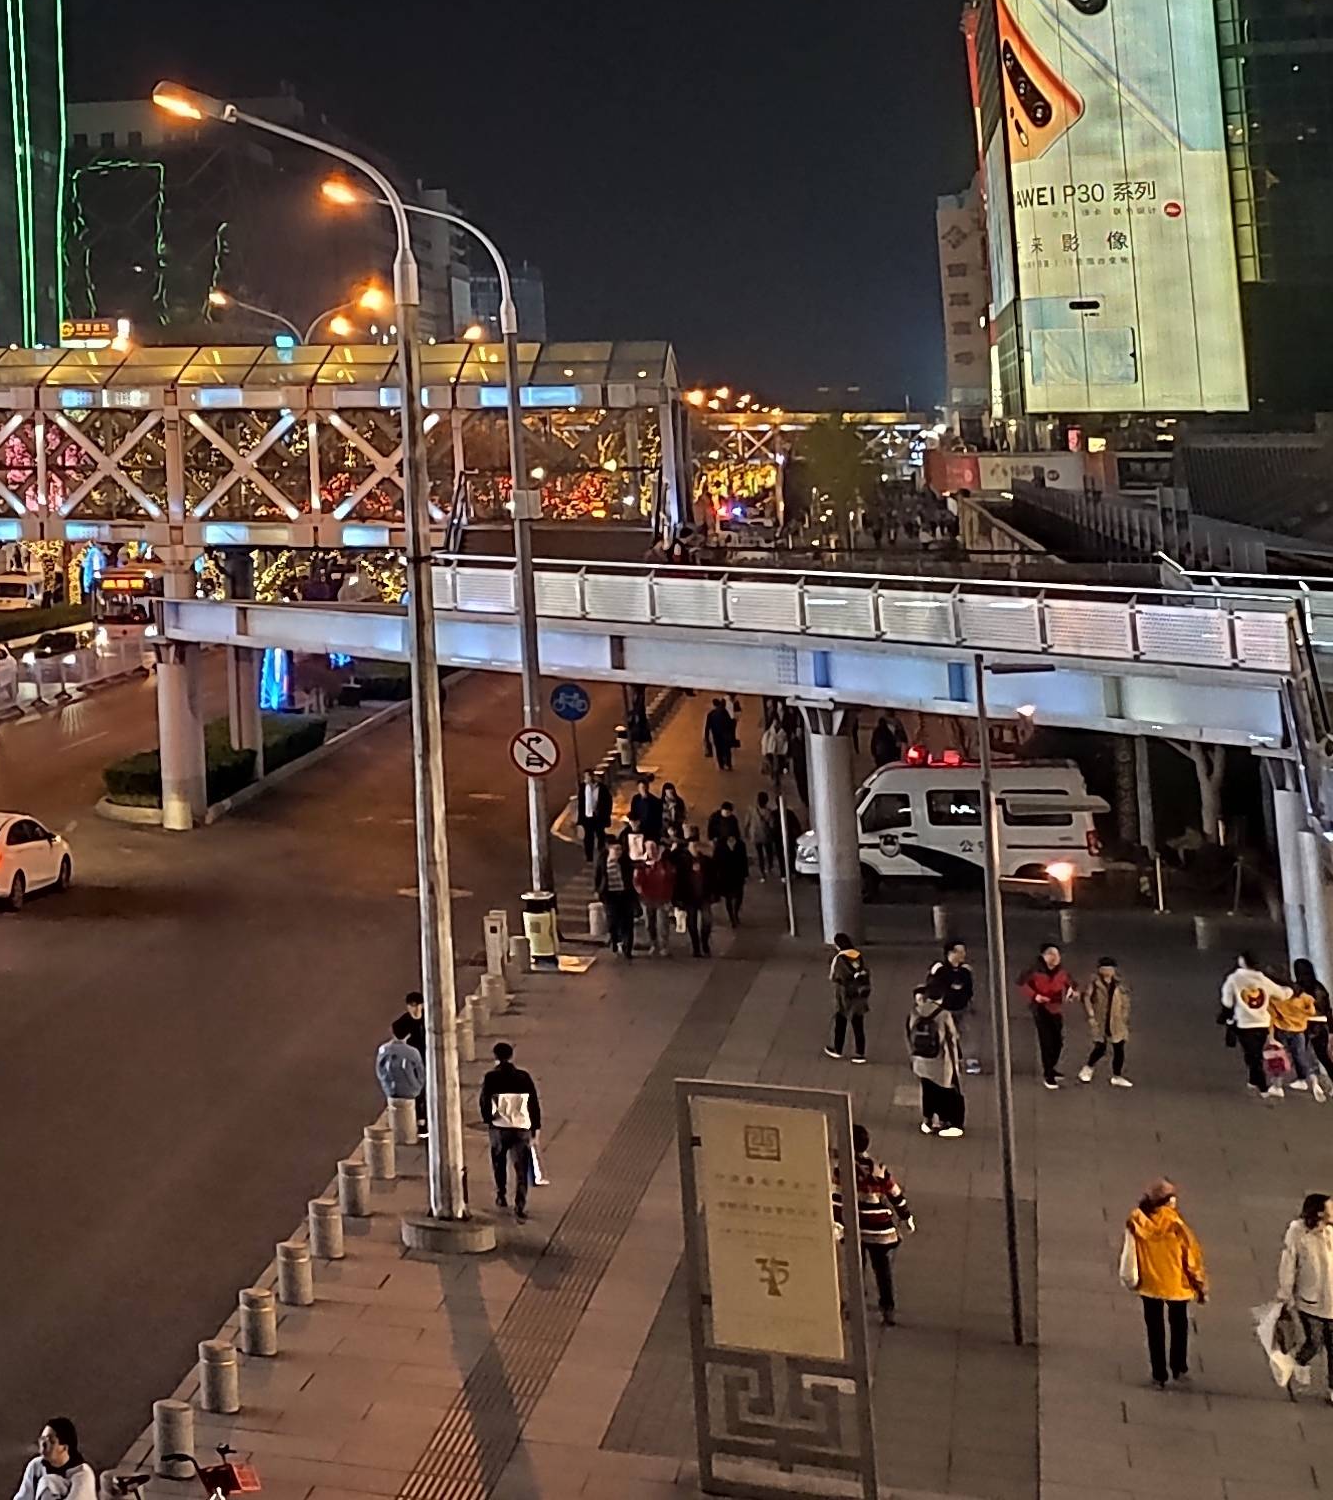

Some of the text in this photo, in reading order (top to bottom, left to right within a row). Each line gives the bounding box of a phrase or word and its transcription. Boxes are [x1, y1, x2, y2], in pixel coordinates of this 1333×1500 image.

[1014, 180, 1157, 210] AWEI P30 系列
